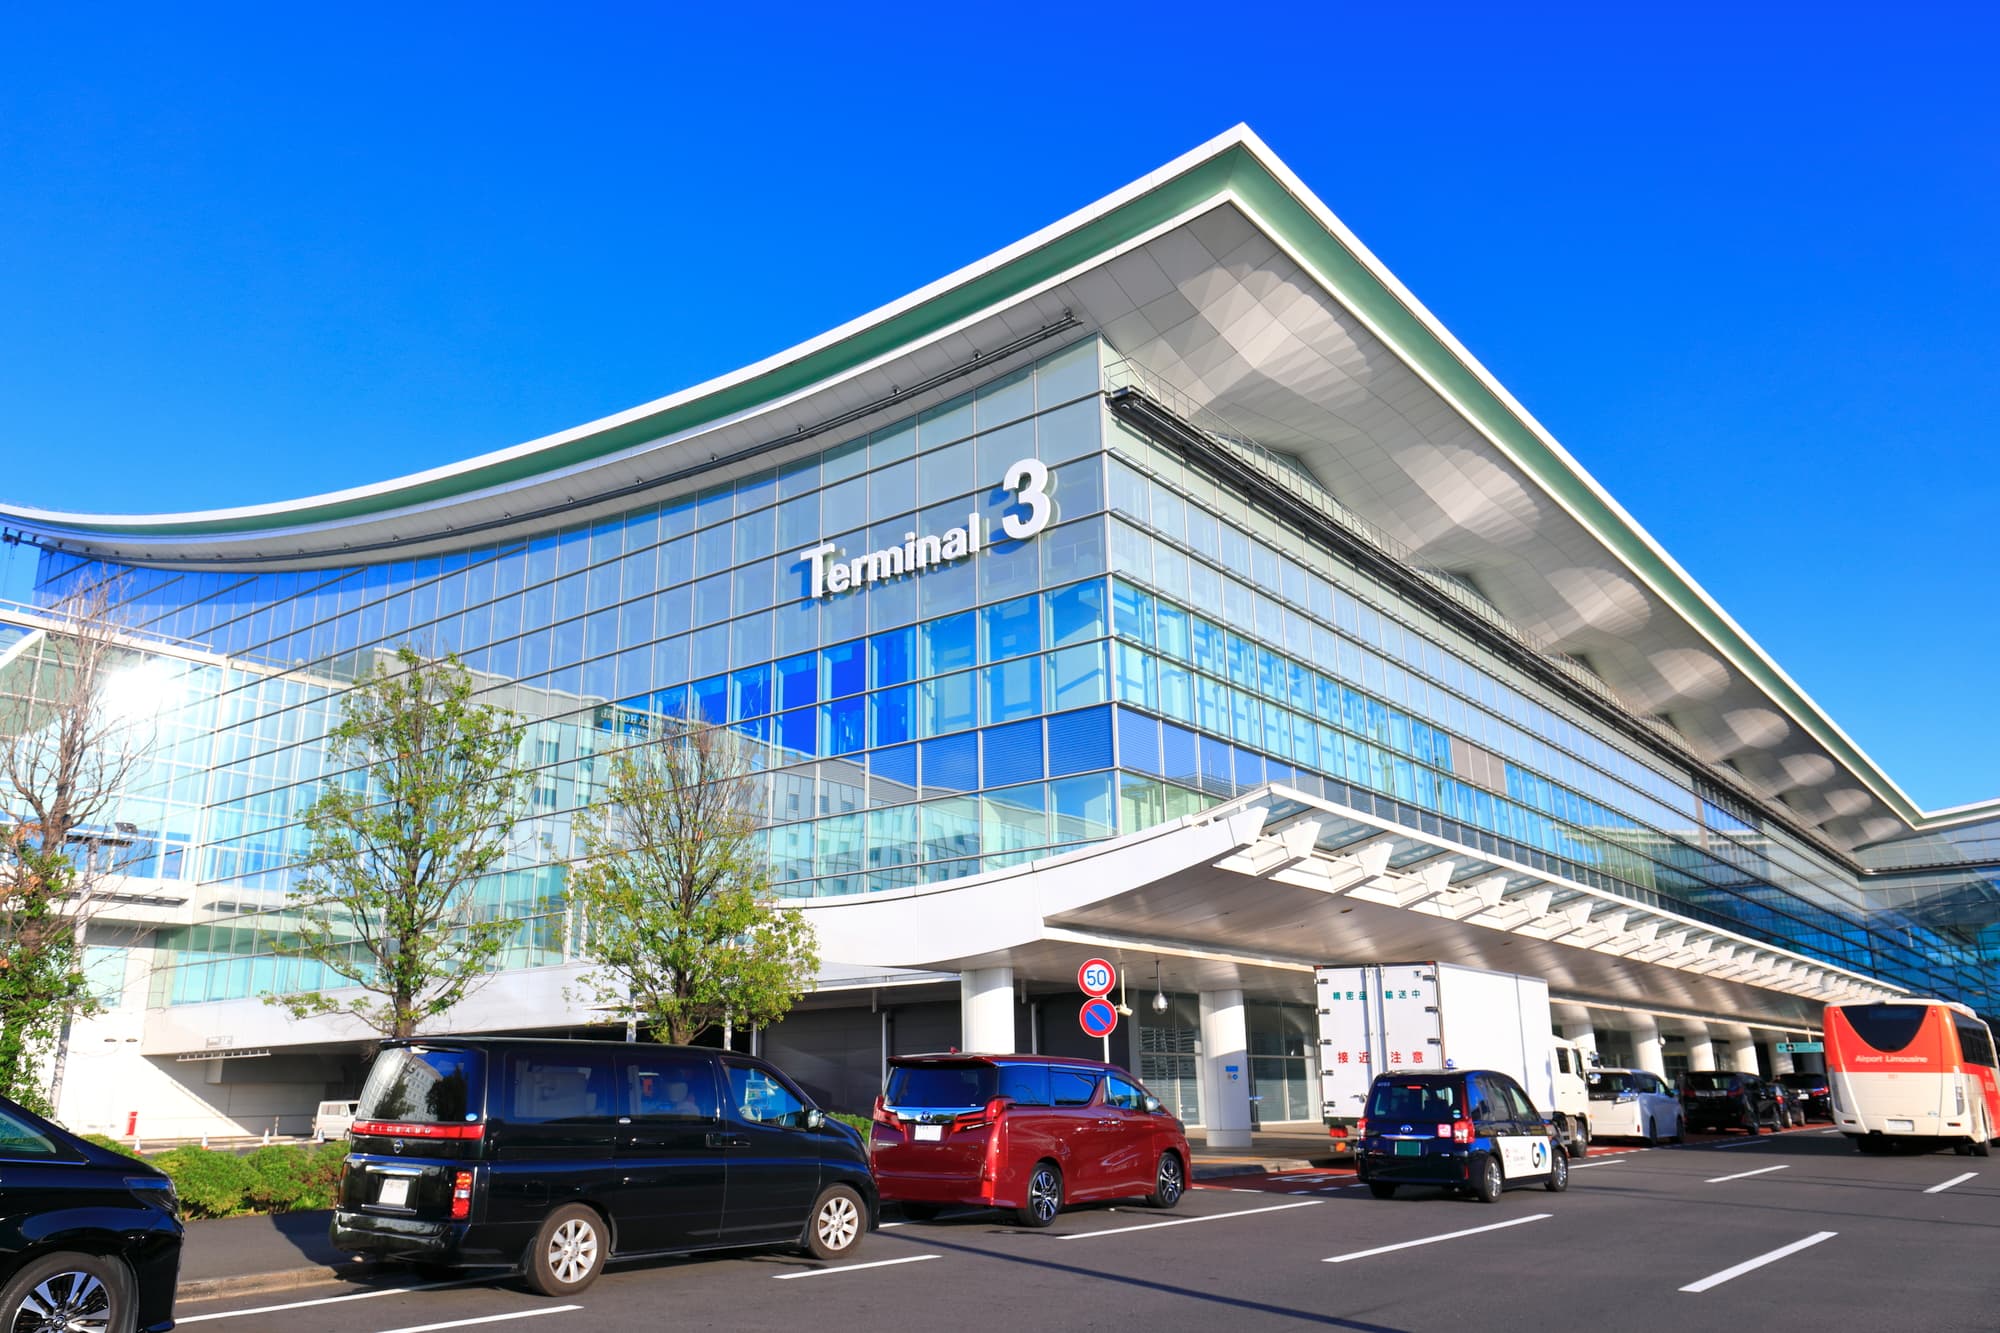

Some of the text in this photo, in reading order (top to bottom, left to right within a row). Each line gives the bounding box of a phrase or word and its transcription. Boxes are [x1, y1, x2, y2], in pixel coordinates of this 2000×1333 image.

[799, 458, 1052, 598] Terminal 3
[1086, 969, 1107, 986] 50
[1337, 1051, 1424, 1064] 接近 注意
[1855, 1055, 1929, 1064] Airport Limousine
